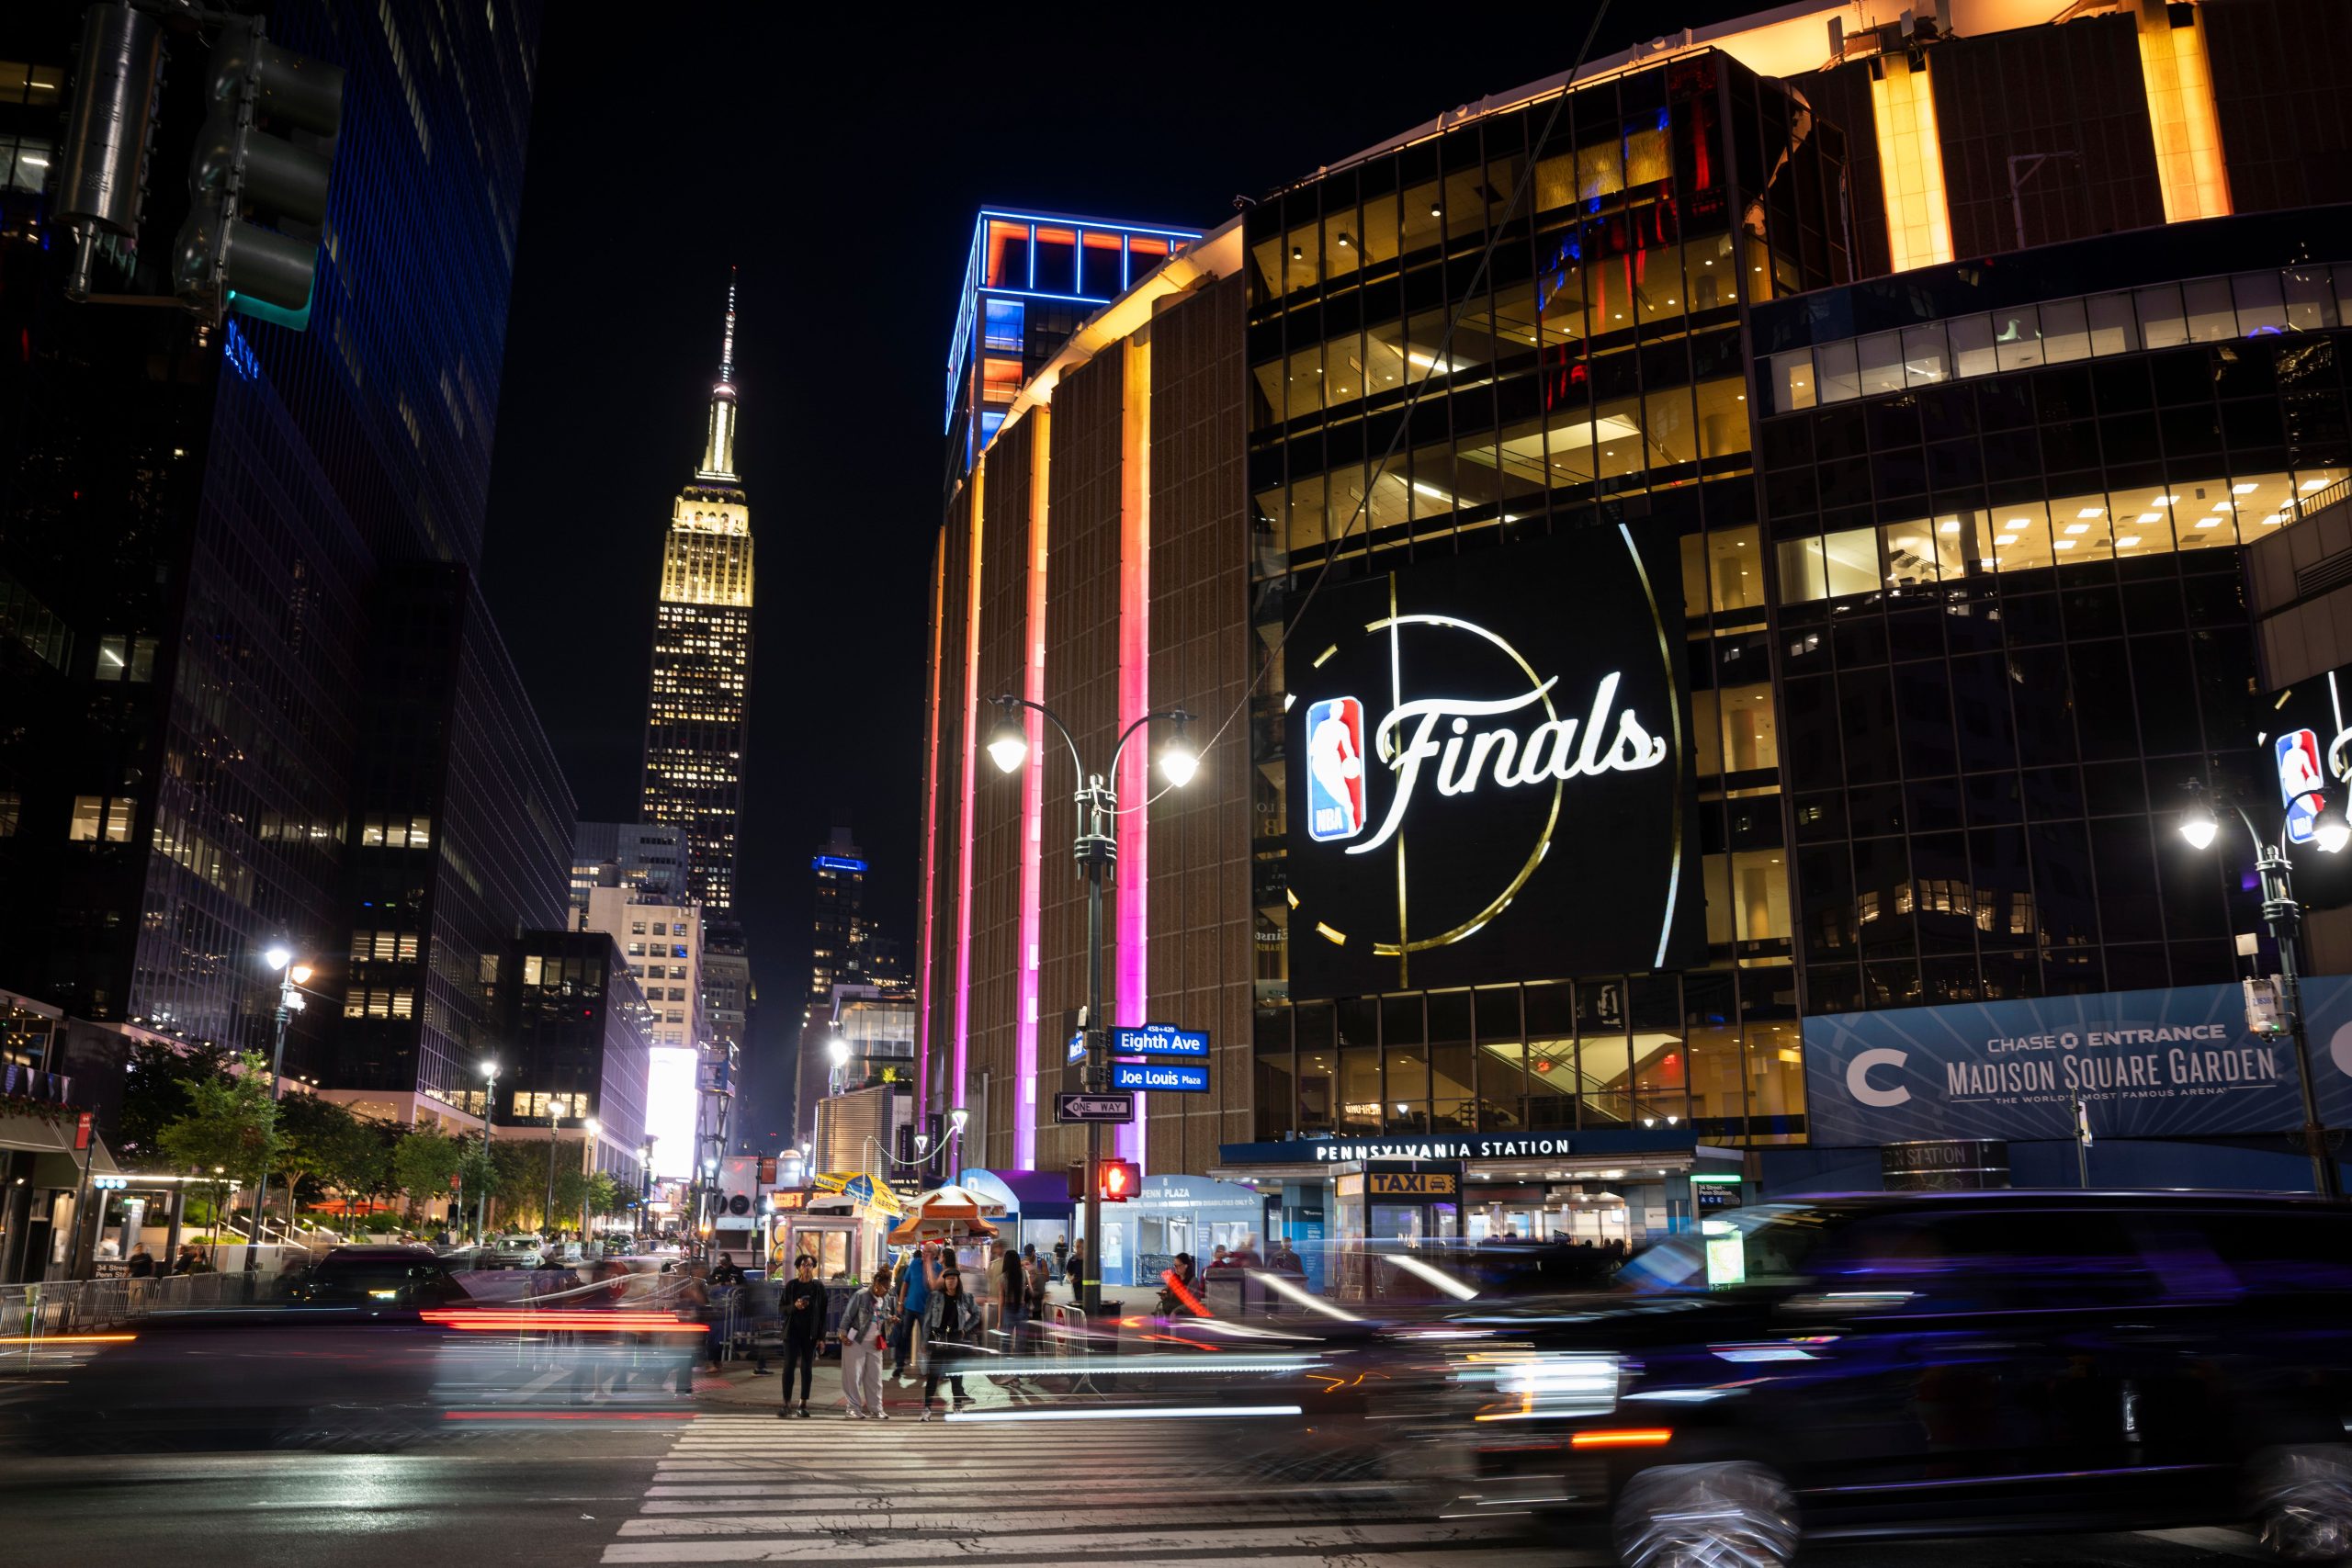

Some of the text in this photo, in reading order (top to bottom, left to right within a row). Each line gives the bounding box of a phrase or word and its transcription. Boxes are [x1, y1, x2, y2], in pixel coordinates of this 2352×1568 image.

[1345, 671, 1667, 854] Finals
[1315, 807, 1343, 833] NBA
[1121, 1032, 1201, 1051] Eighth Ave
[1987, 1024, 2226, 1053] CHASE ENTRANCE
[1121, 1070, 1201, 1085] Joe Louis Plaza
[1846, 1048, 1911, 1108] C
[1947, 1048, 2276, 1096] MADISON SQUARE GARDEN
[2082, 1092, 2117, 1100] MOST
[2122, 1089, 2175, 1100] FAMOUS
[1073, 1102, 1122, 1111] ONE WAY
[1317, 1139, 1569, 1160] PENNSYLVANIA STATION
[1906, 1145, 1966, 1167] STATION
[1141, 1188, 1190, 1199] PENN PLAZA
[1374, 1174, 1426, 1192] TAXI
